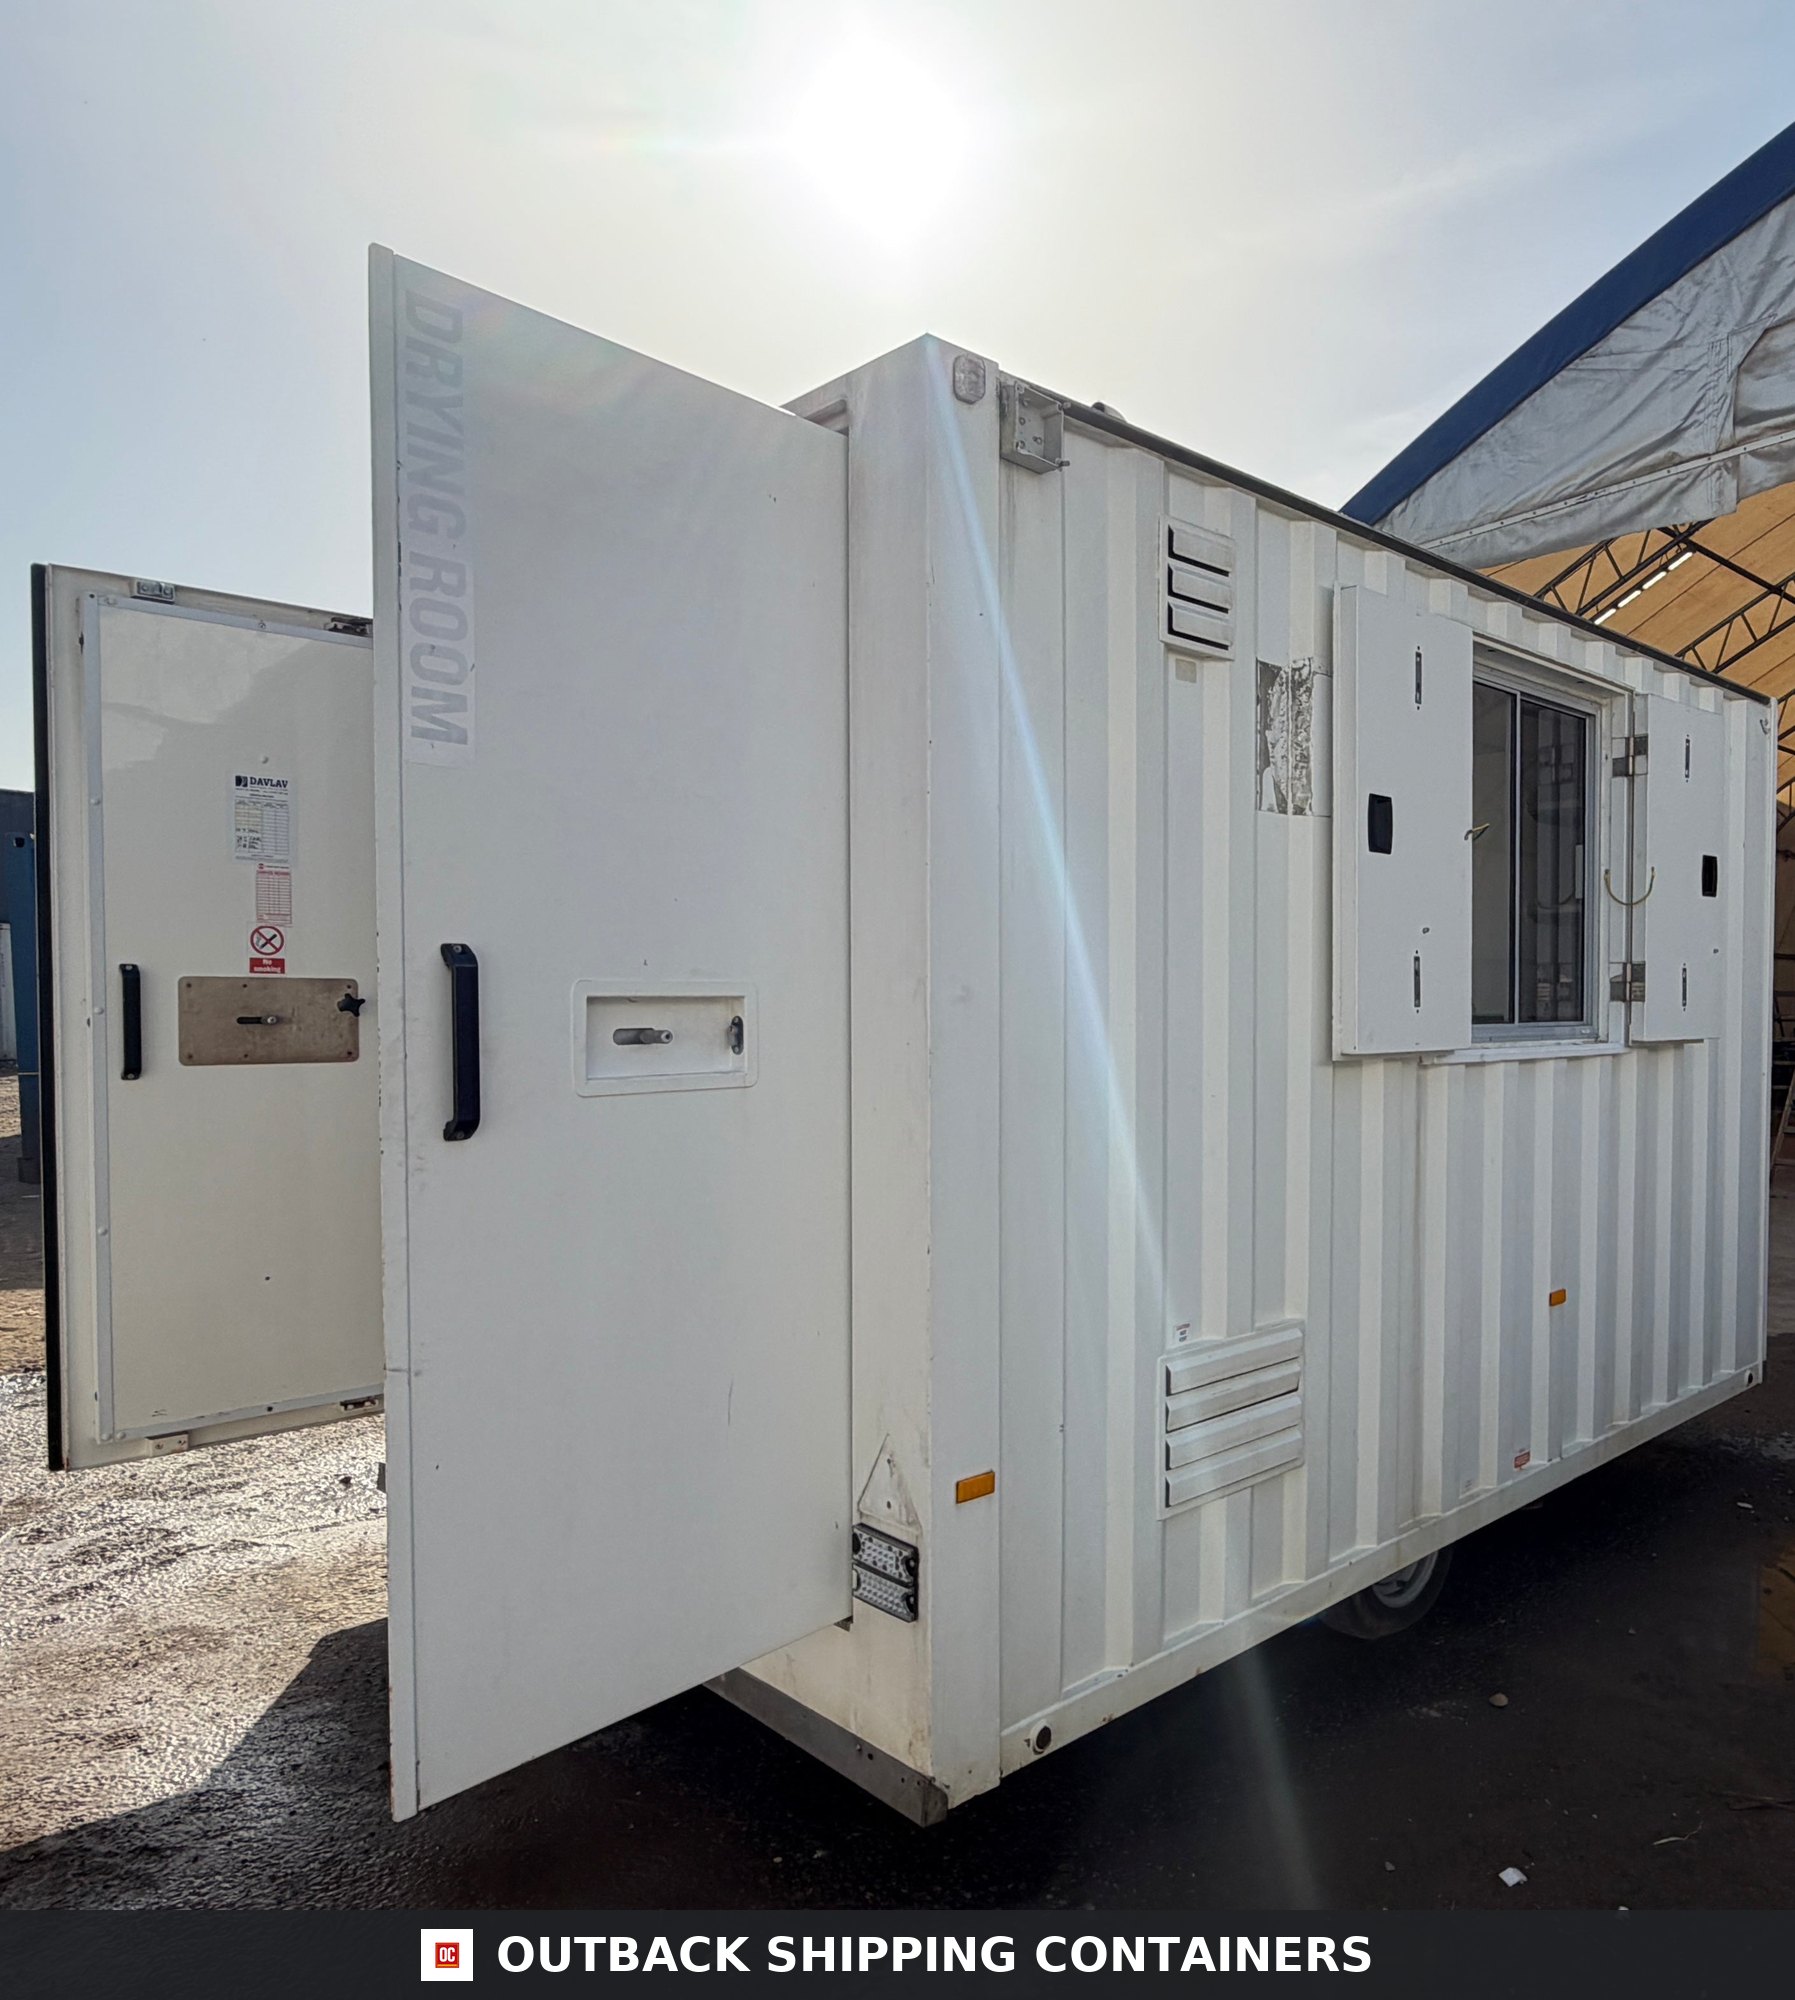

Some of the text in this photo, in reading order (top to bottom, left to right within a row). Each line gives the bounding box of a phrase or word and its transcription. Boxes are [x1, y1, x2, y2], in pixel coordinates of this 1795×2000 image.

[405, 287, 469, 746] DRYING ROOM
[249, 776, 289, 789] DAVLAV
[262, 958, 273, 966] No
